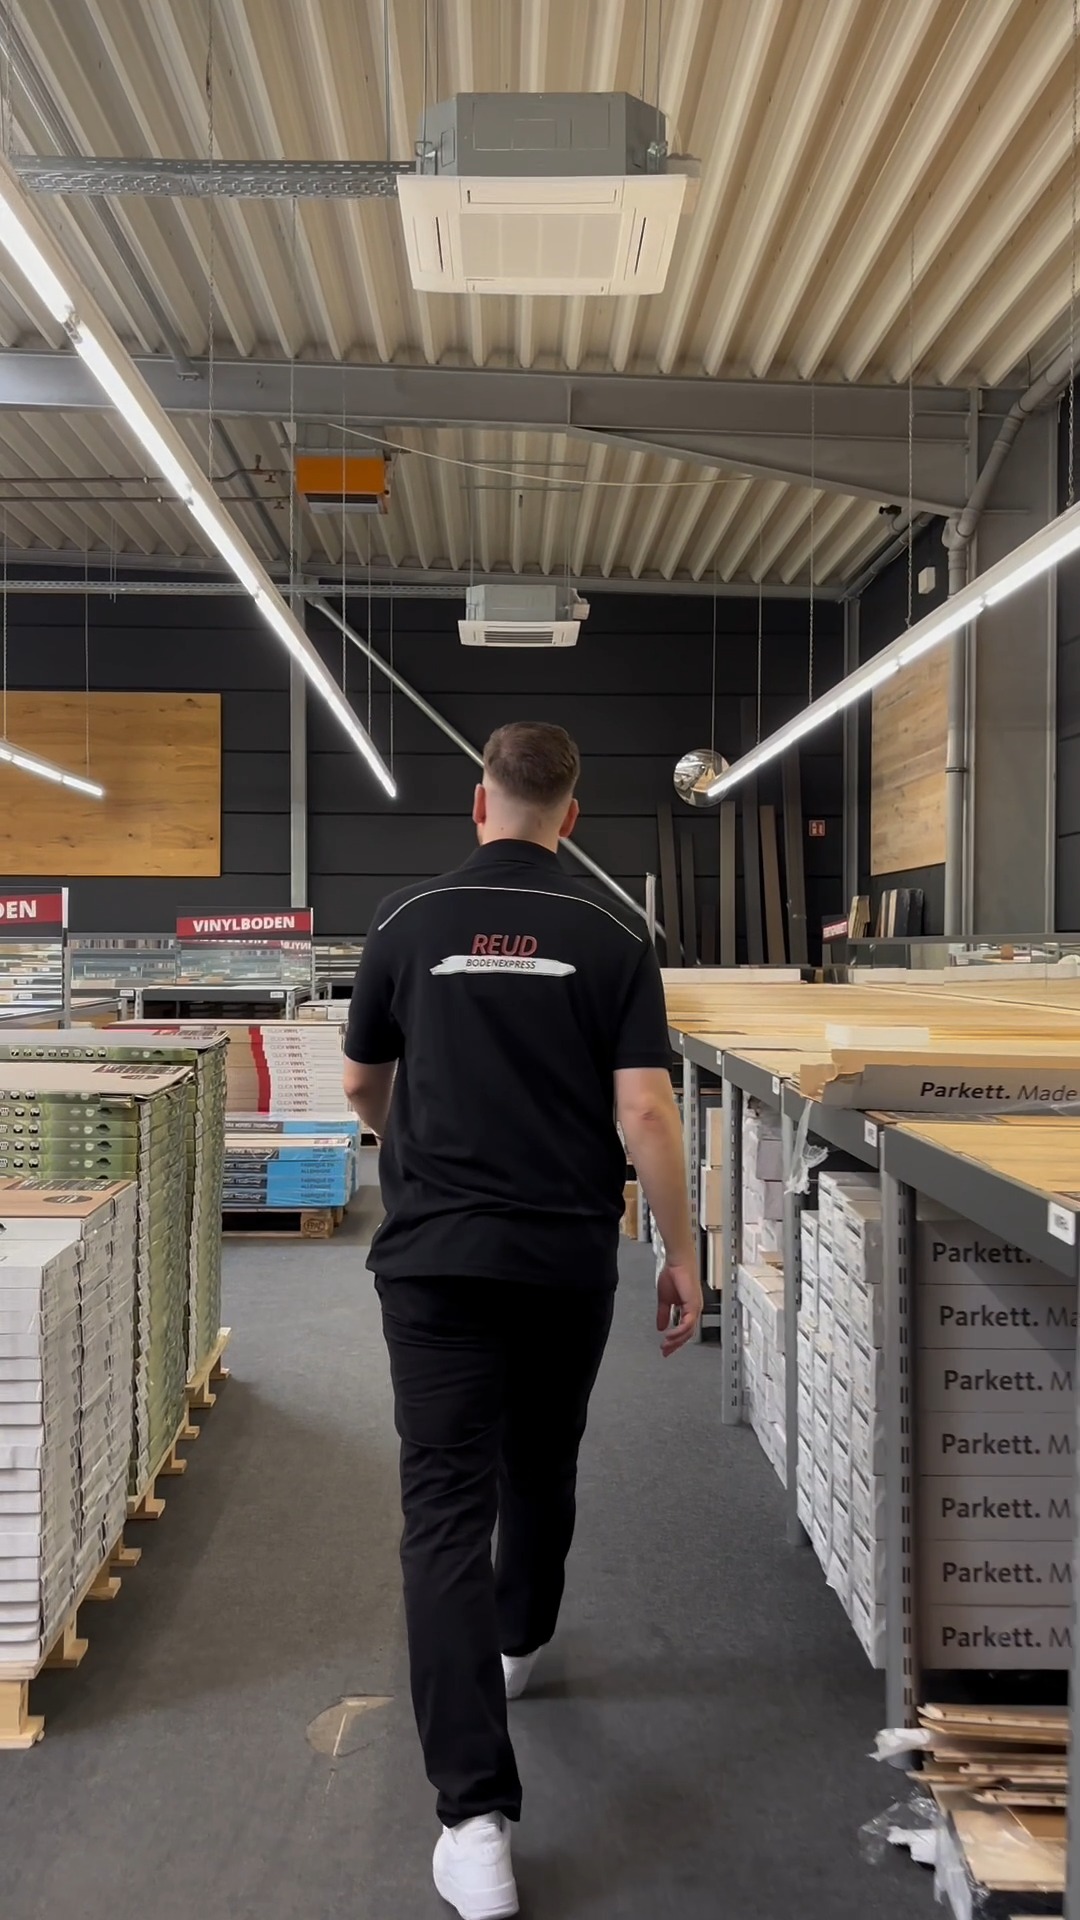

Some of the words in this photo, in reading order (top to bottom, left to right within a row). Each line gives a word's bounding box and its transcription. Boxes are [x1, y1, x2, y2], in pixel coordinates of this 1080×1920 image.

[192, 916, 295, 932] VINYLBODEN
[472, 934, 537, 956] REUD
[466, 959, 536, 969] BODENEXPRESS
[920, 1082, 1010, 1099] Parkett.
[1017, 1085, 1078, 1101] Made
[932, 1241, 1031, 1263] Parkett.
[940, 1305, 1039, 1327] Parkett.
[944, 1369, 1043, 1391] Parkett.
[941, 1432, 1040, 1454] Parkett.
[941, 1496, 1041, 1518] Parkett.
[942, 1561, 1042, 1583] Parkett.
[941, 1625, 1042, 1648] Parkett.
